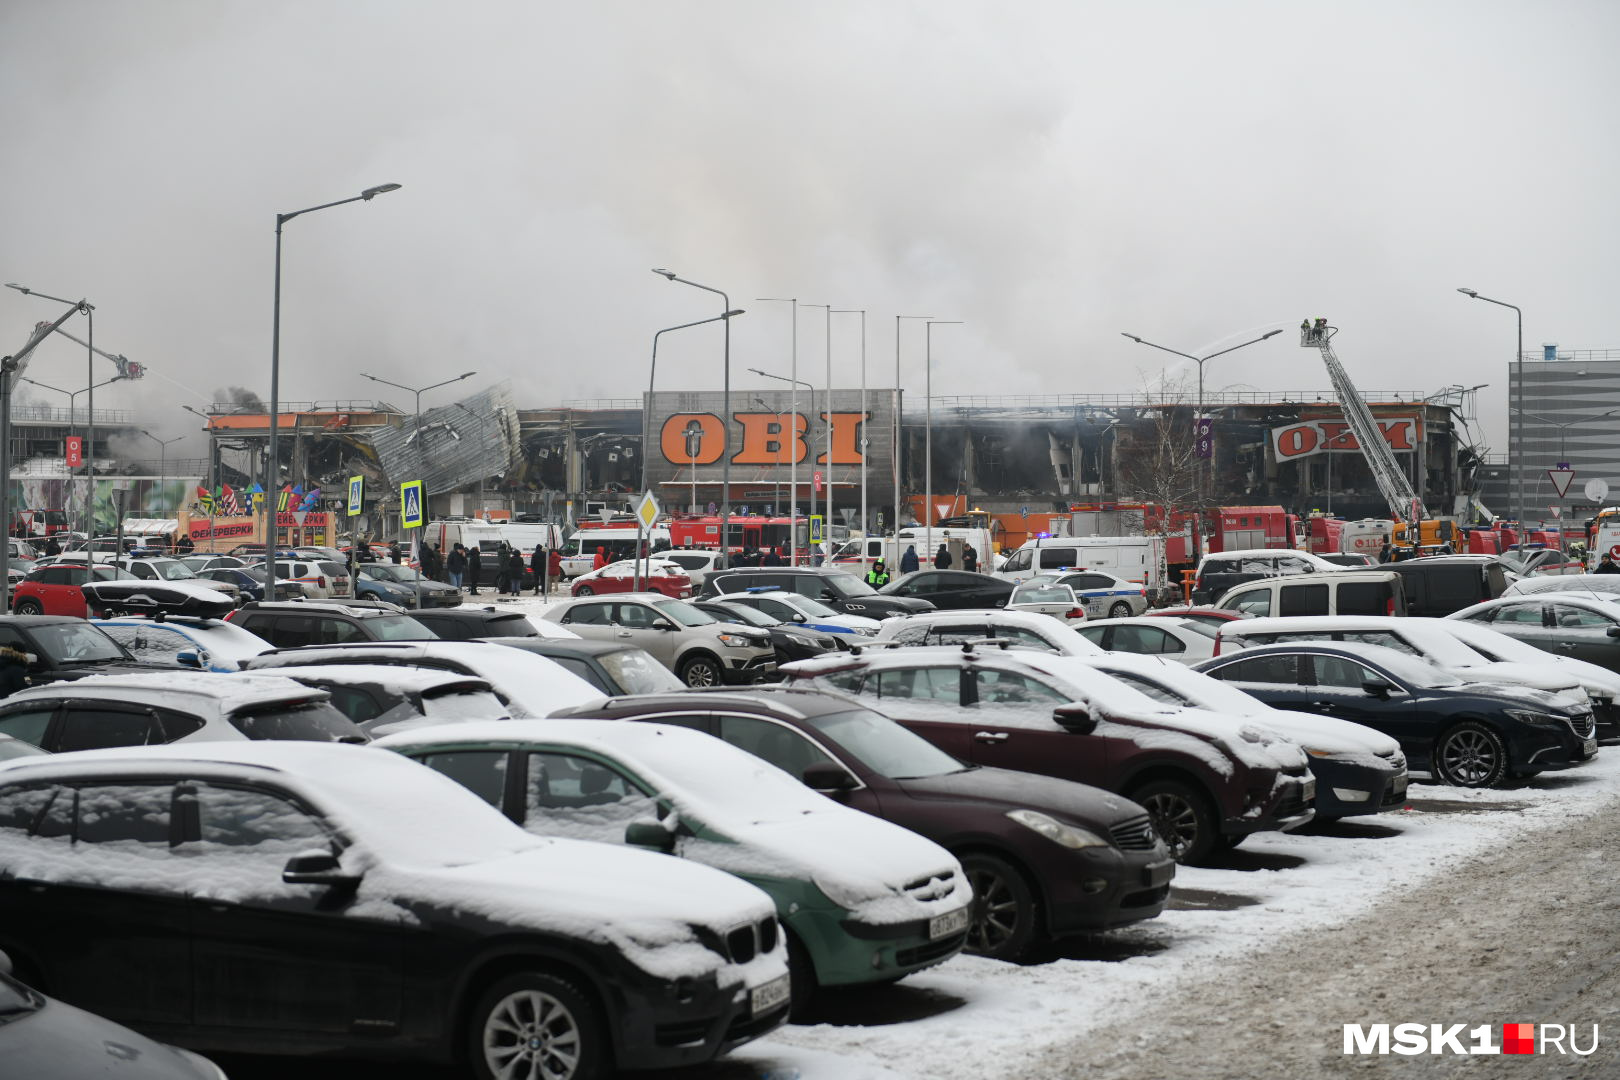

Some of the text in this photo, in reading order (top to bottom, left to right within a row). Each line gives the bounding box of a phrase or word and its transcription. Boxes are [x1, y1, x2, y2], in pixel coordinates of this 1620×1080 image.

[660, 411, 872, 465] OBI
[71, 454, 77, 462] 5
[191, 524, 254, 538] ФЕЙЕРВЕРКИ
[1366, 538, 1384, 548] 112
